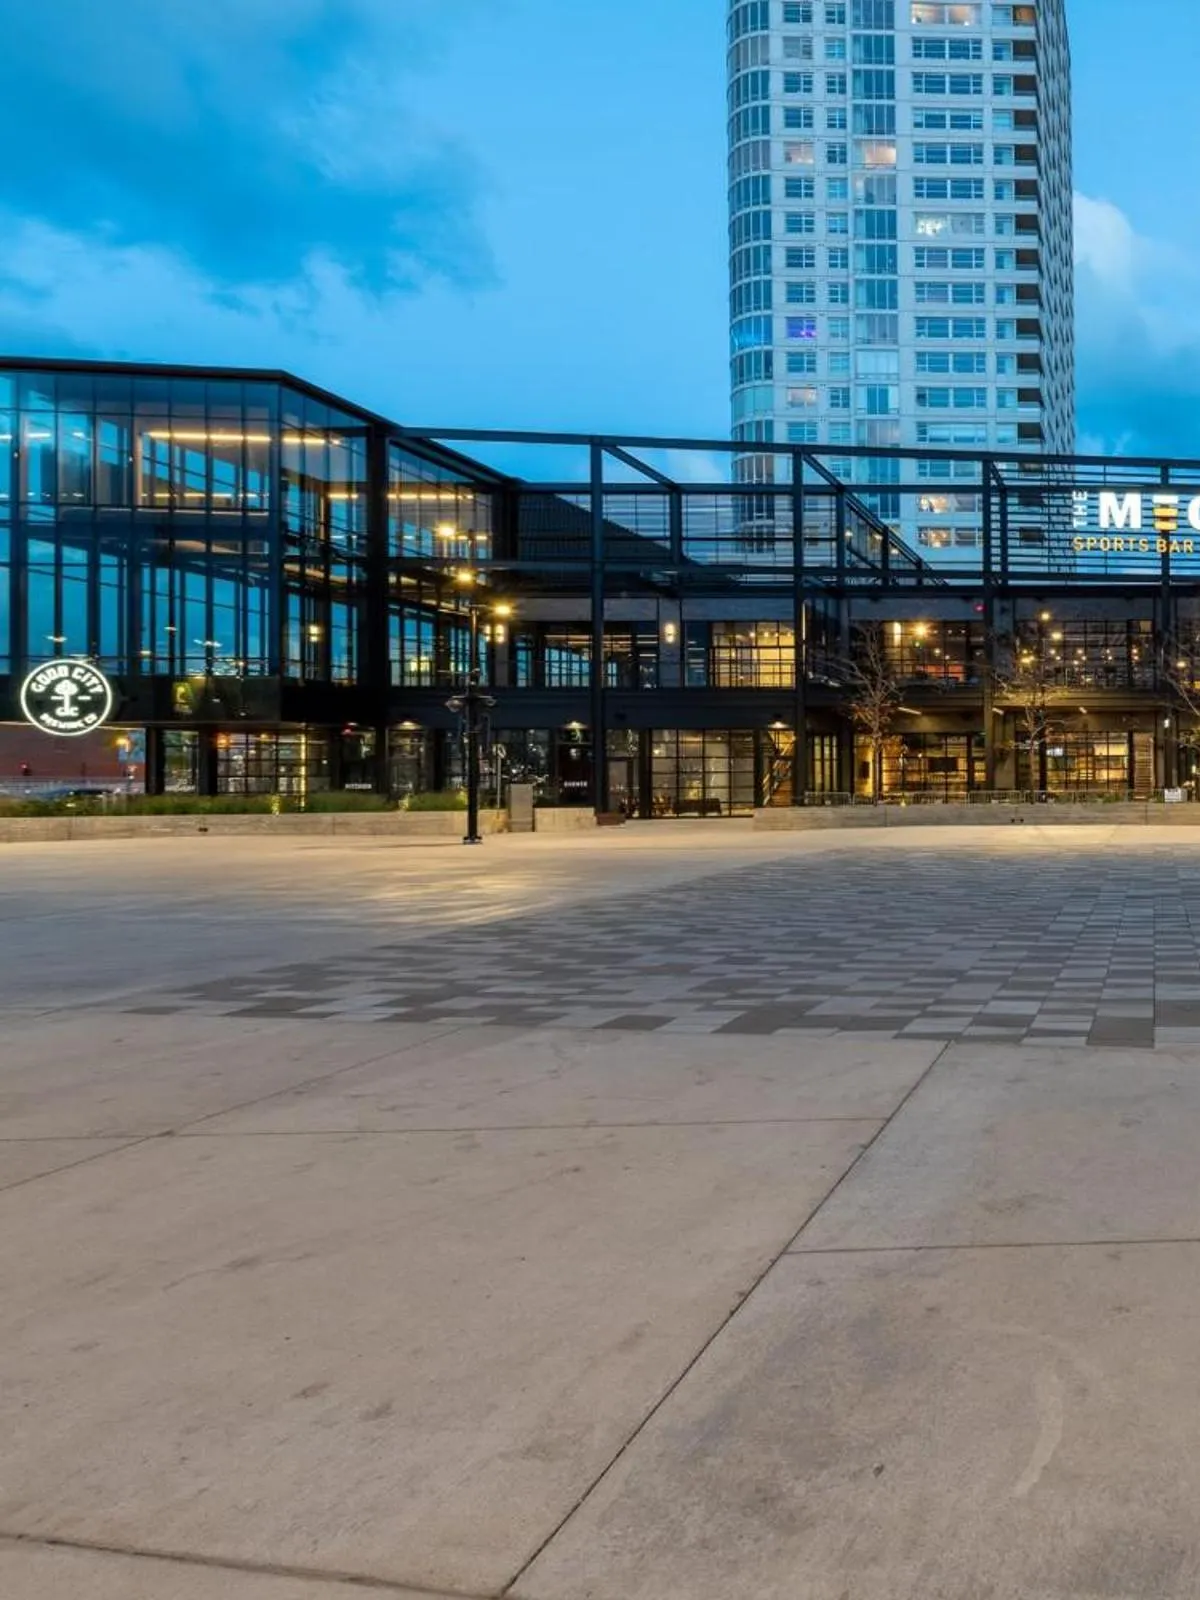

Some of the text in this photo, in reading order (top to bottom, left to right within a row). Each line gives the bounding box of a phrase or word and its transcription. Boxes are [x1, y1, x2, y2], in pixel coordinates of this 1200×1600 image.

[1072, 491, 1087, 528] THE
[1072, 536, 1149, 552] SPORTS
[1156, 540, 1193, 553] BAR
[31, 665, 103, 692] GOOD CITY
